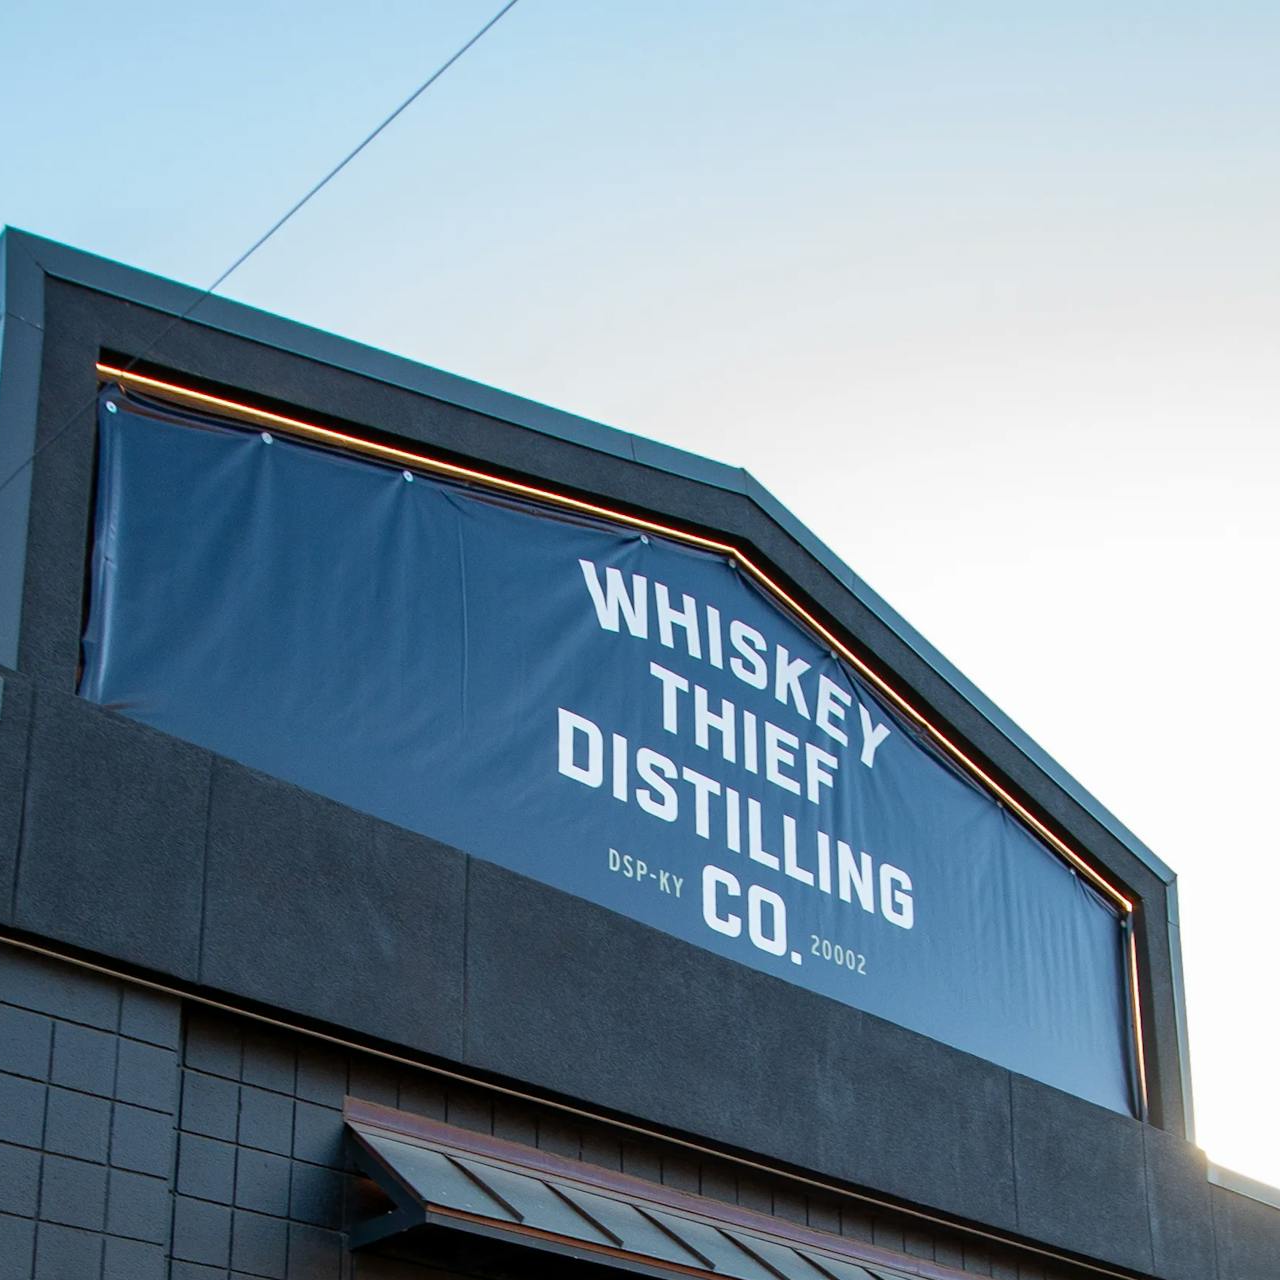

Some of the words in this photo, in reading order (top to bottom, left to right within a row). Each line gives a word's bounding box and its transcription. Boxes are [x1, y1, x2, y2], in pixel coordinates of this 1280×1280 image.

[579, 558, 891, 768] WHISKEY
[650, 661, 838, 804] THIEF
[557, 707, 914, 929] DISTILLING
[608, 847, 683, 898] DSP-KY
[701, 864, 802, 965] CO.
[810, 935, 867, 975] 20002
